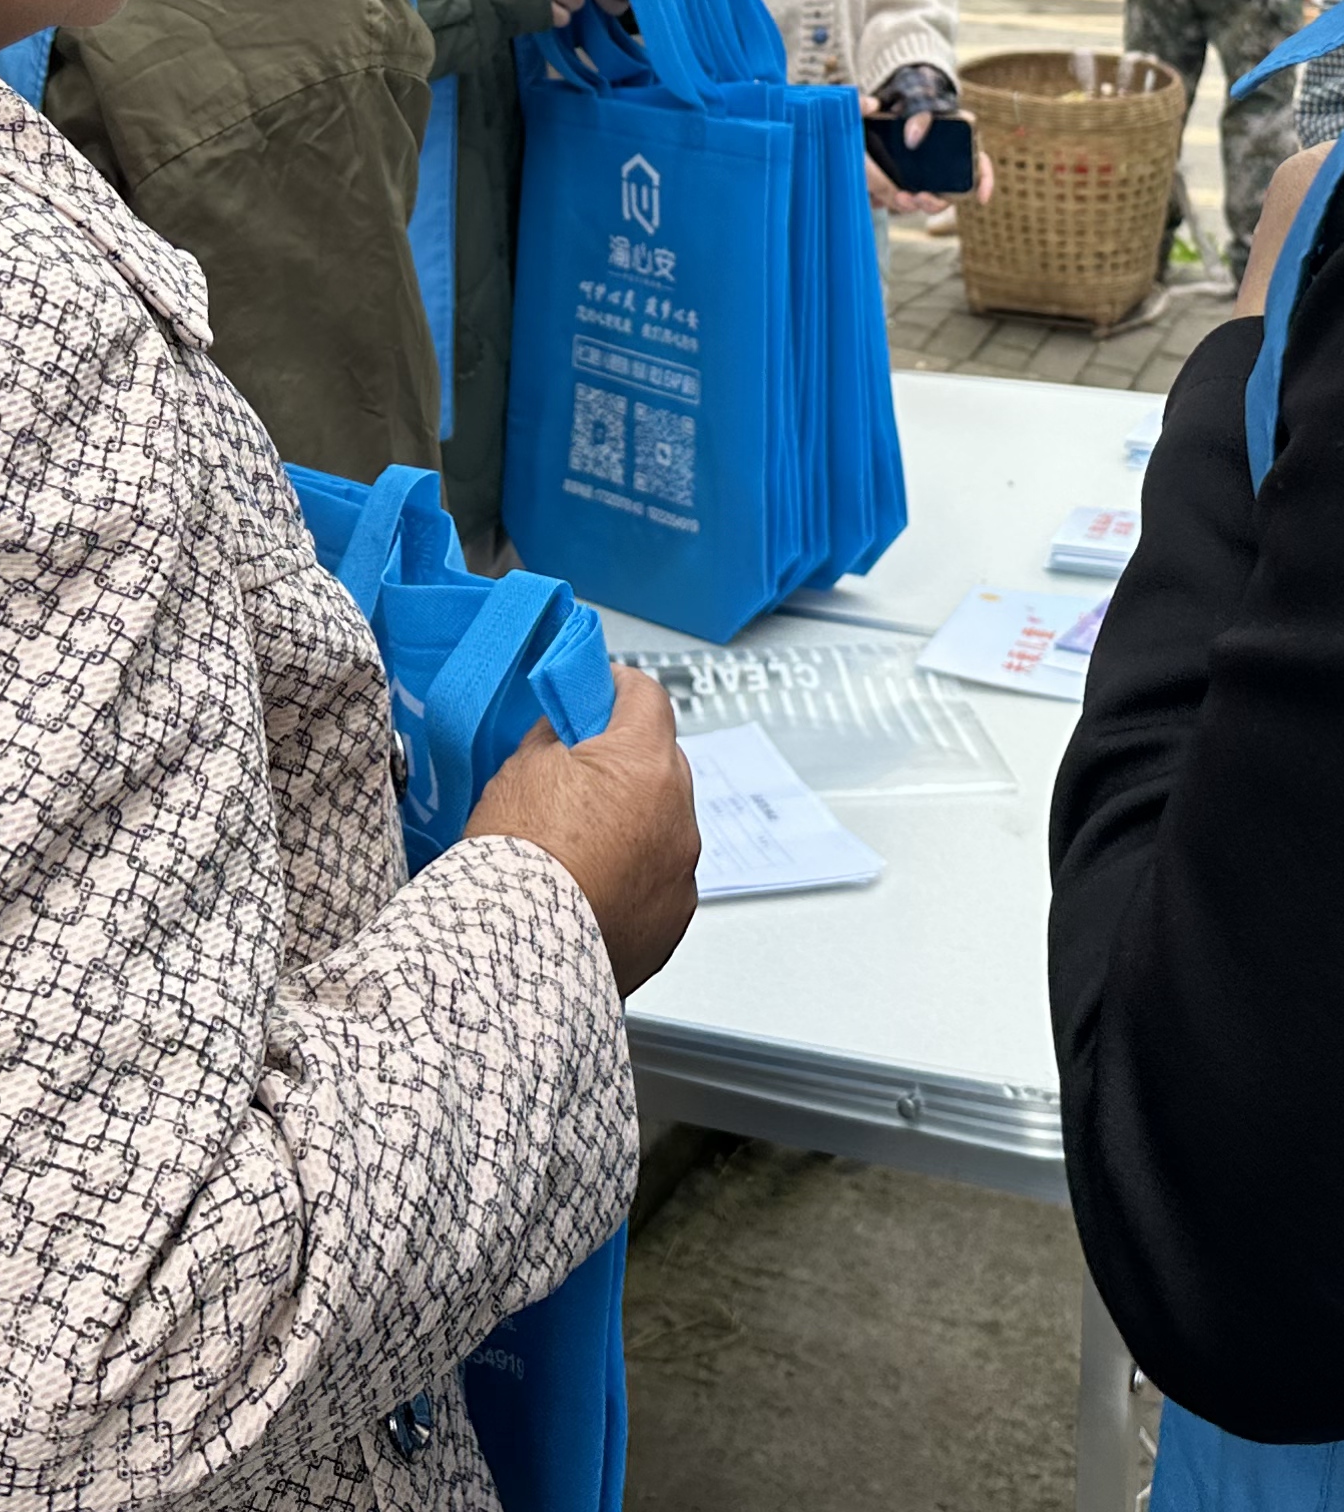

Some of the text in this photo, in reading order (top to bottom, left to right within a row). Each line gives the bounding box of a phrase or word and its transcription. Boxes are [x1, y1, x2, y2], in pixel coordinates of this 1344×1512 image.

[609, 235, 676, 282] 渝心安
[687, 659, 820, 696] CLEAR
